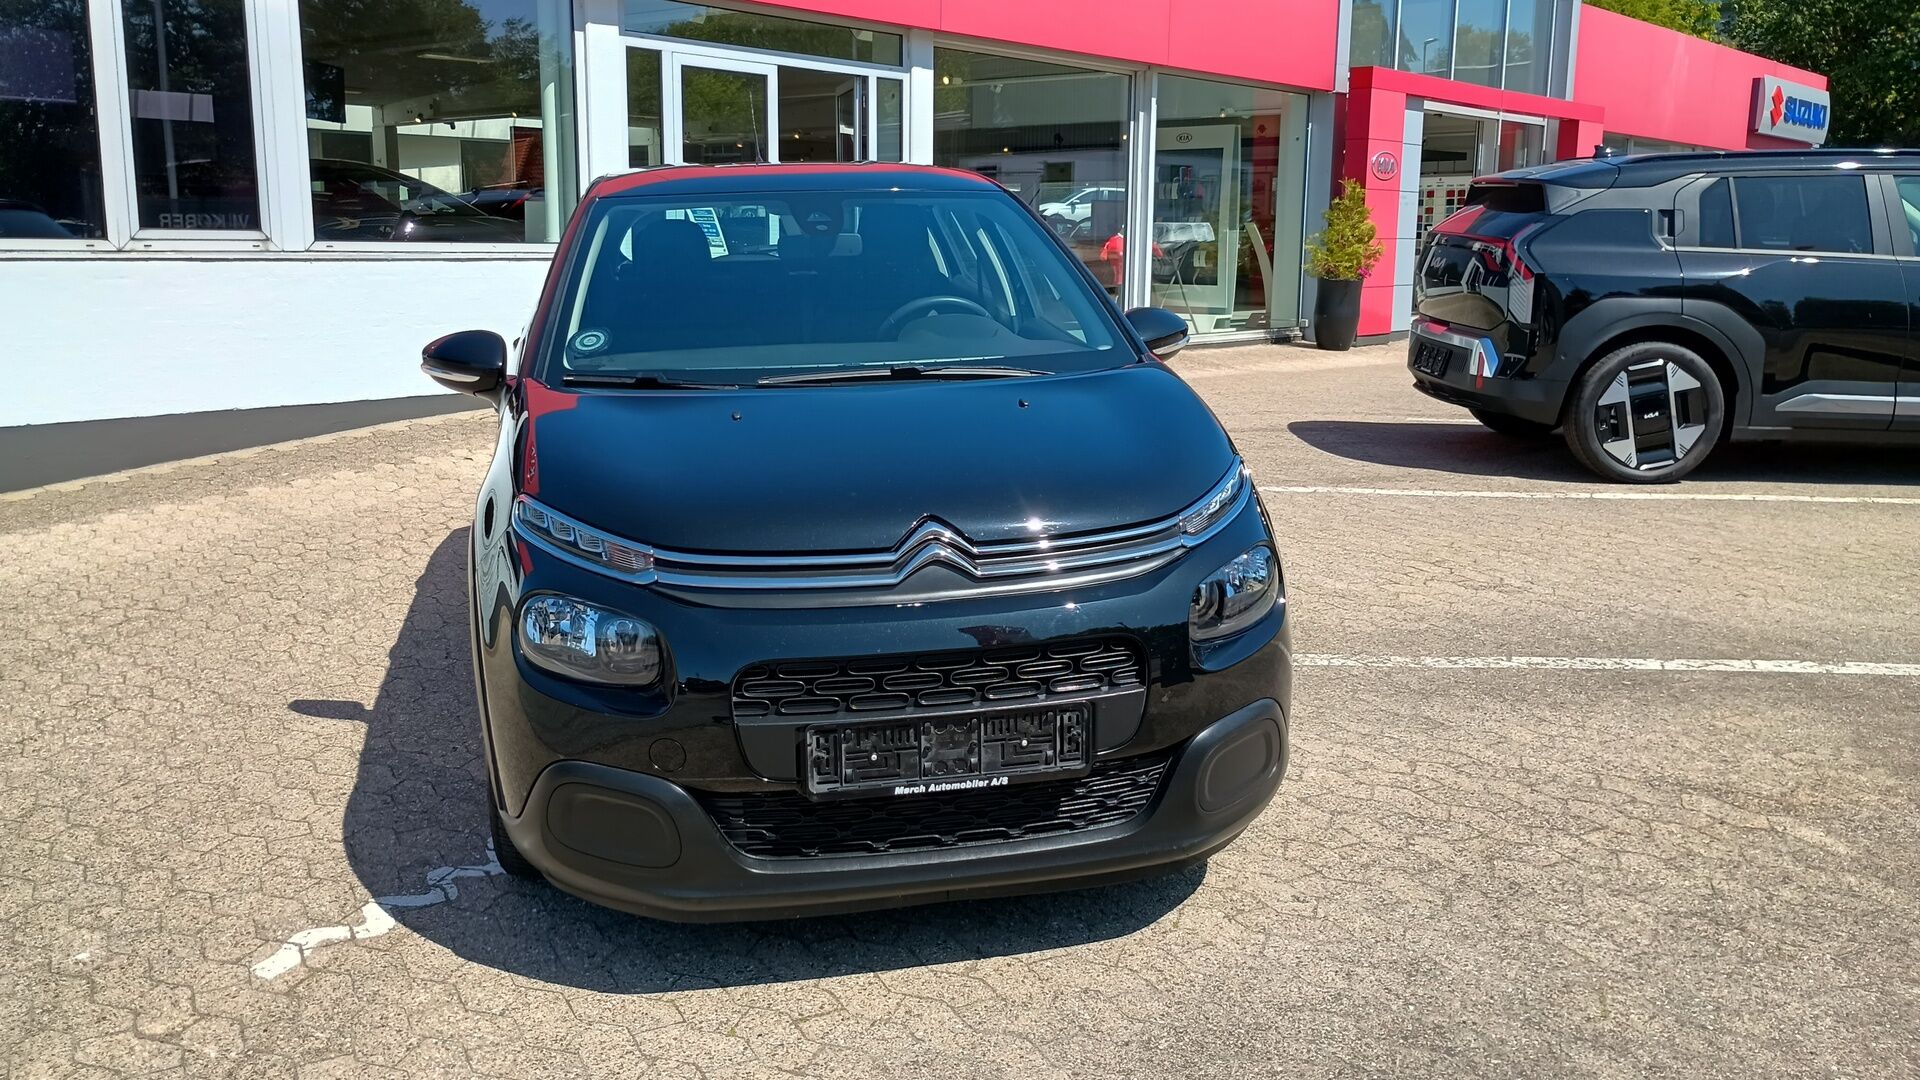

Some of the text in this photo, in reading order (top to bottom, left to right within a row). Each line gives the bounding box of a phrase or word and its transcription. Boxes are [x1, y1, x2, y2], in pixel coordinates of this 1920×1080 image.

[1784, 95, 1827, 130] SUZUKI
[928, 780, 989, 792] Automobiler
[991, 777, 1009, 786] A/S
